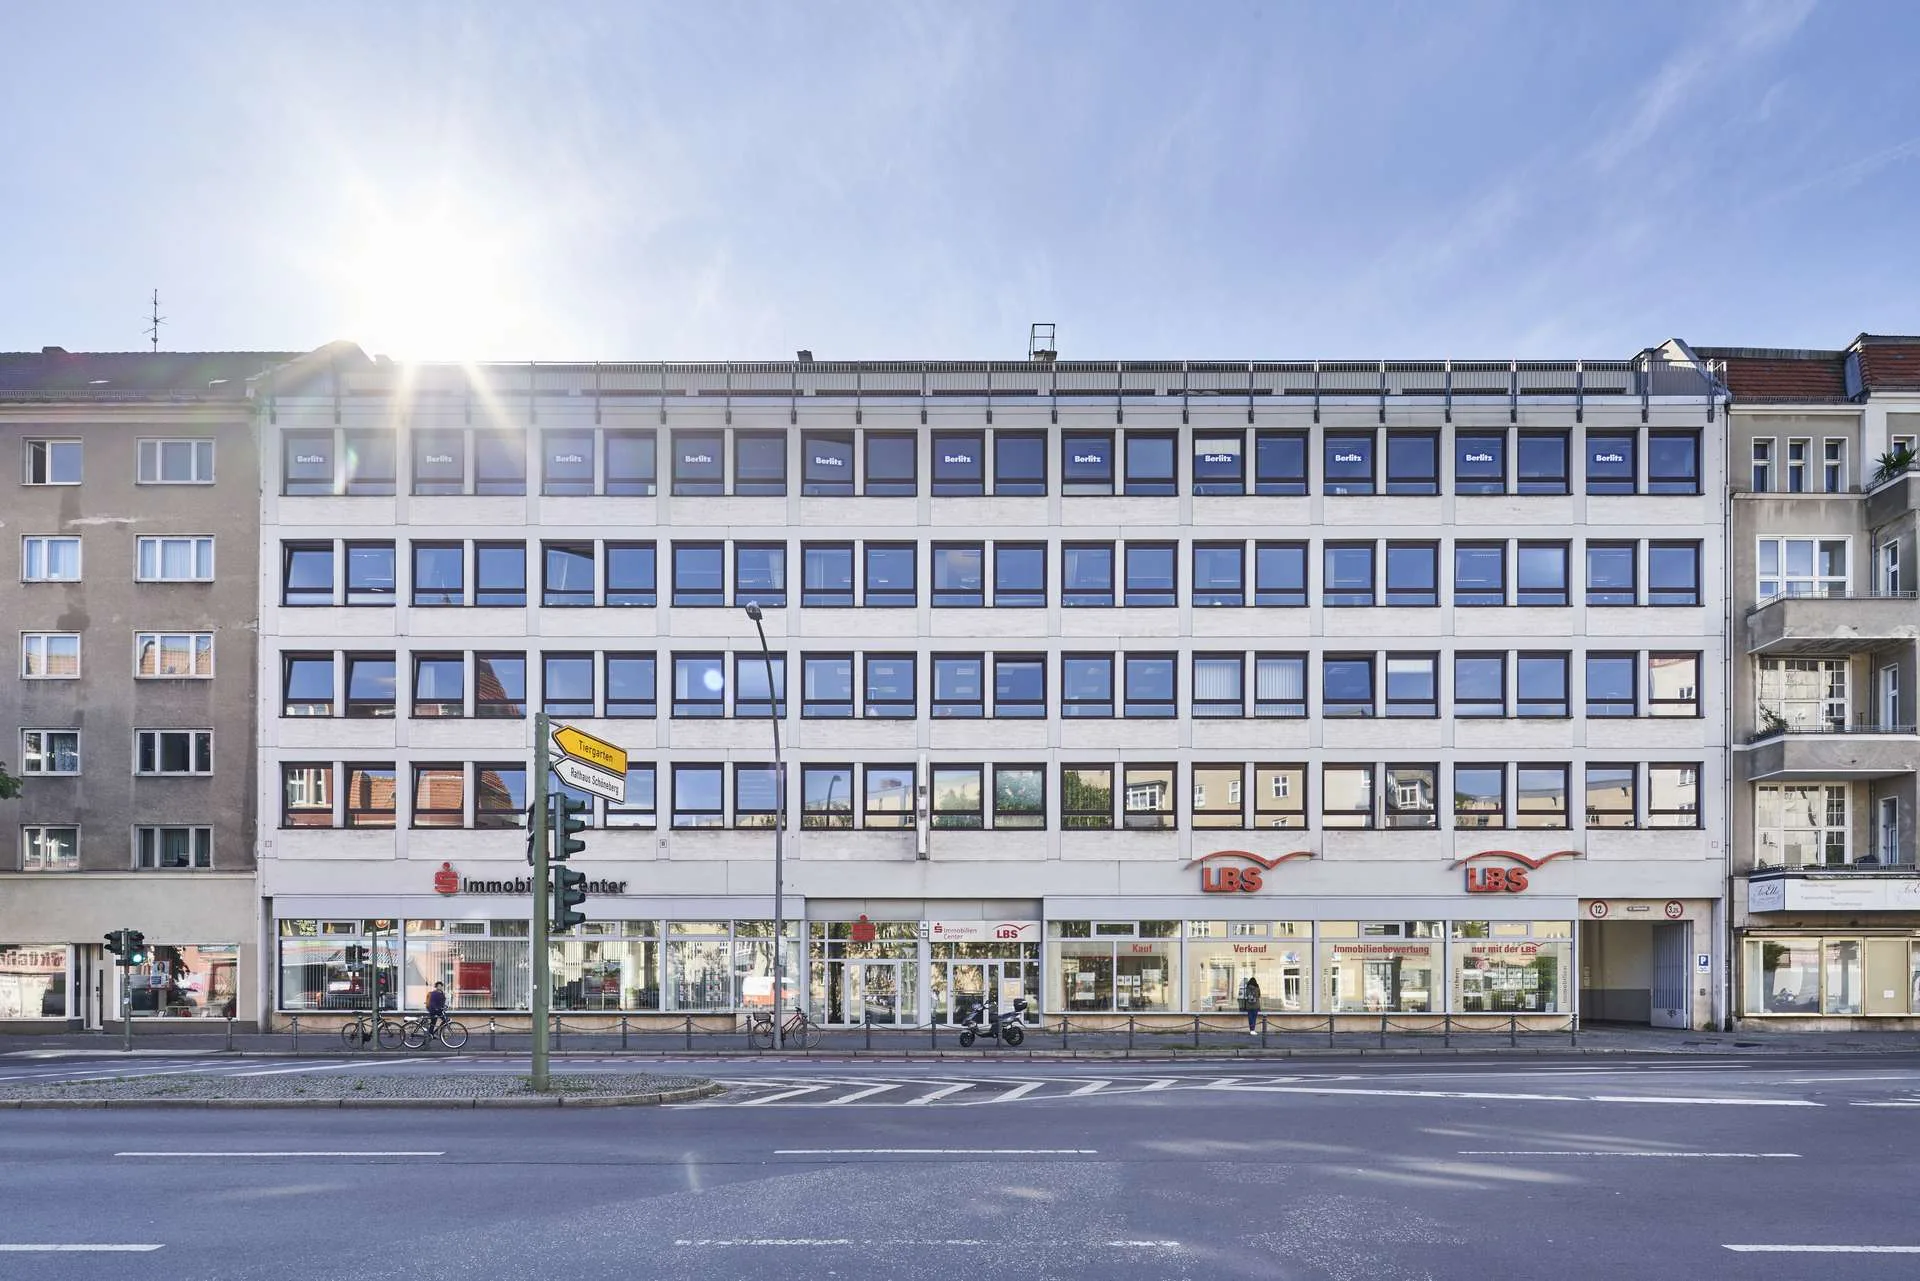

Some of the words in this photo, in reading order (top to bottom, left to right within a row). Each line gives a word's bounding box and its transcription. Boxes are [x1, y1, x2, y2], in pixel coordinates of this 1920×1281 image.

[816, 457, 842, 466] Berlitz
[579, 739, 614, 763] Tiergarten
[571, 767, 591, 784] Rathaus
[592, 775, 619, 796] Schöneberg
[1203, 867, 1263, 892] LBS
[1467, 867, 1528, 892] LBS
[1595, 905, 1602, 914] 12
[943, 926, 977, 934] Immobilien
[996, 929, 1018, 939] LBS
[1132, 944, 1152, 953] Kauf
[1233, 944, 1267, 953] Verkauf
[1334, 944, 1429, 955] Immobilienbewertung
[1488, 945, 1502, 953] mit
[1504, 945, 1520, 953] der
[1701, 956, 1706, 965] P
